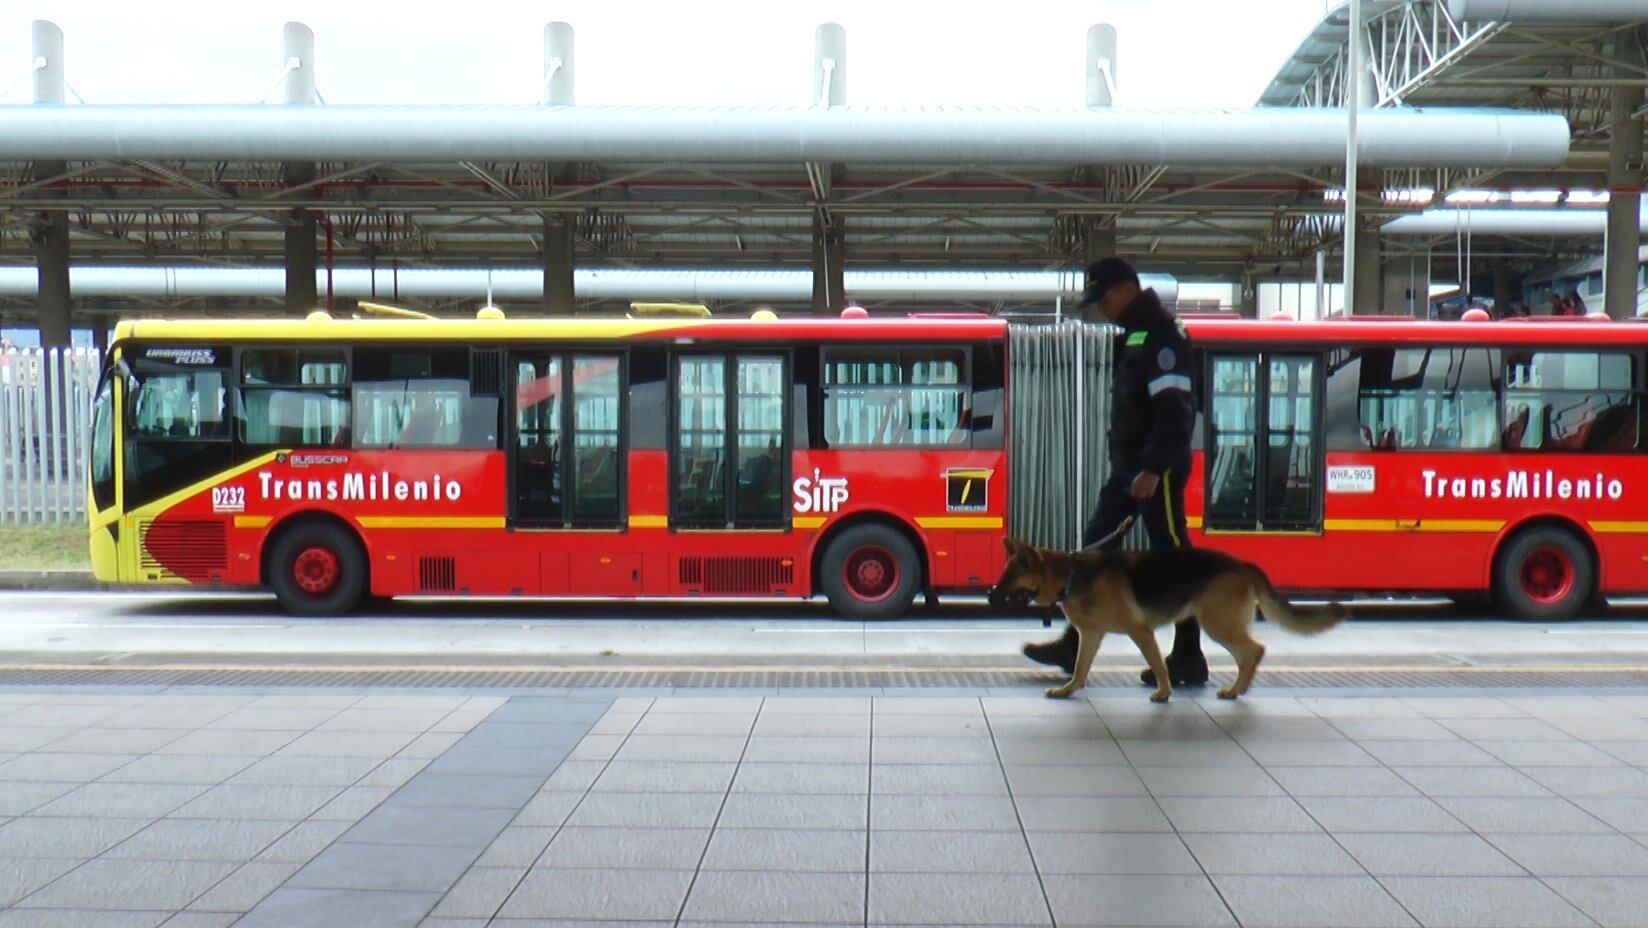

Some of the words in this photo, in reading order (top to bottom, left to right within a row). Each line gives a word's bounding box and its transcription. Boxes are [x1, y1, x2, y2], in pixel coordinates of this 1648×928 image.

[212, 486, 245, 505] D232
[258, 471, 462, 500] TransMilenio
[1422, 470, 1623, 499] TransMilenio
